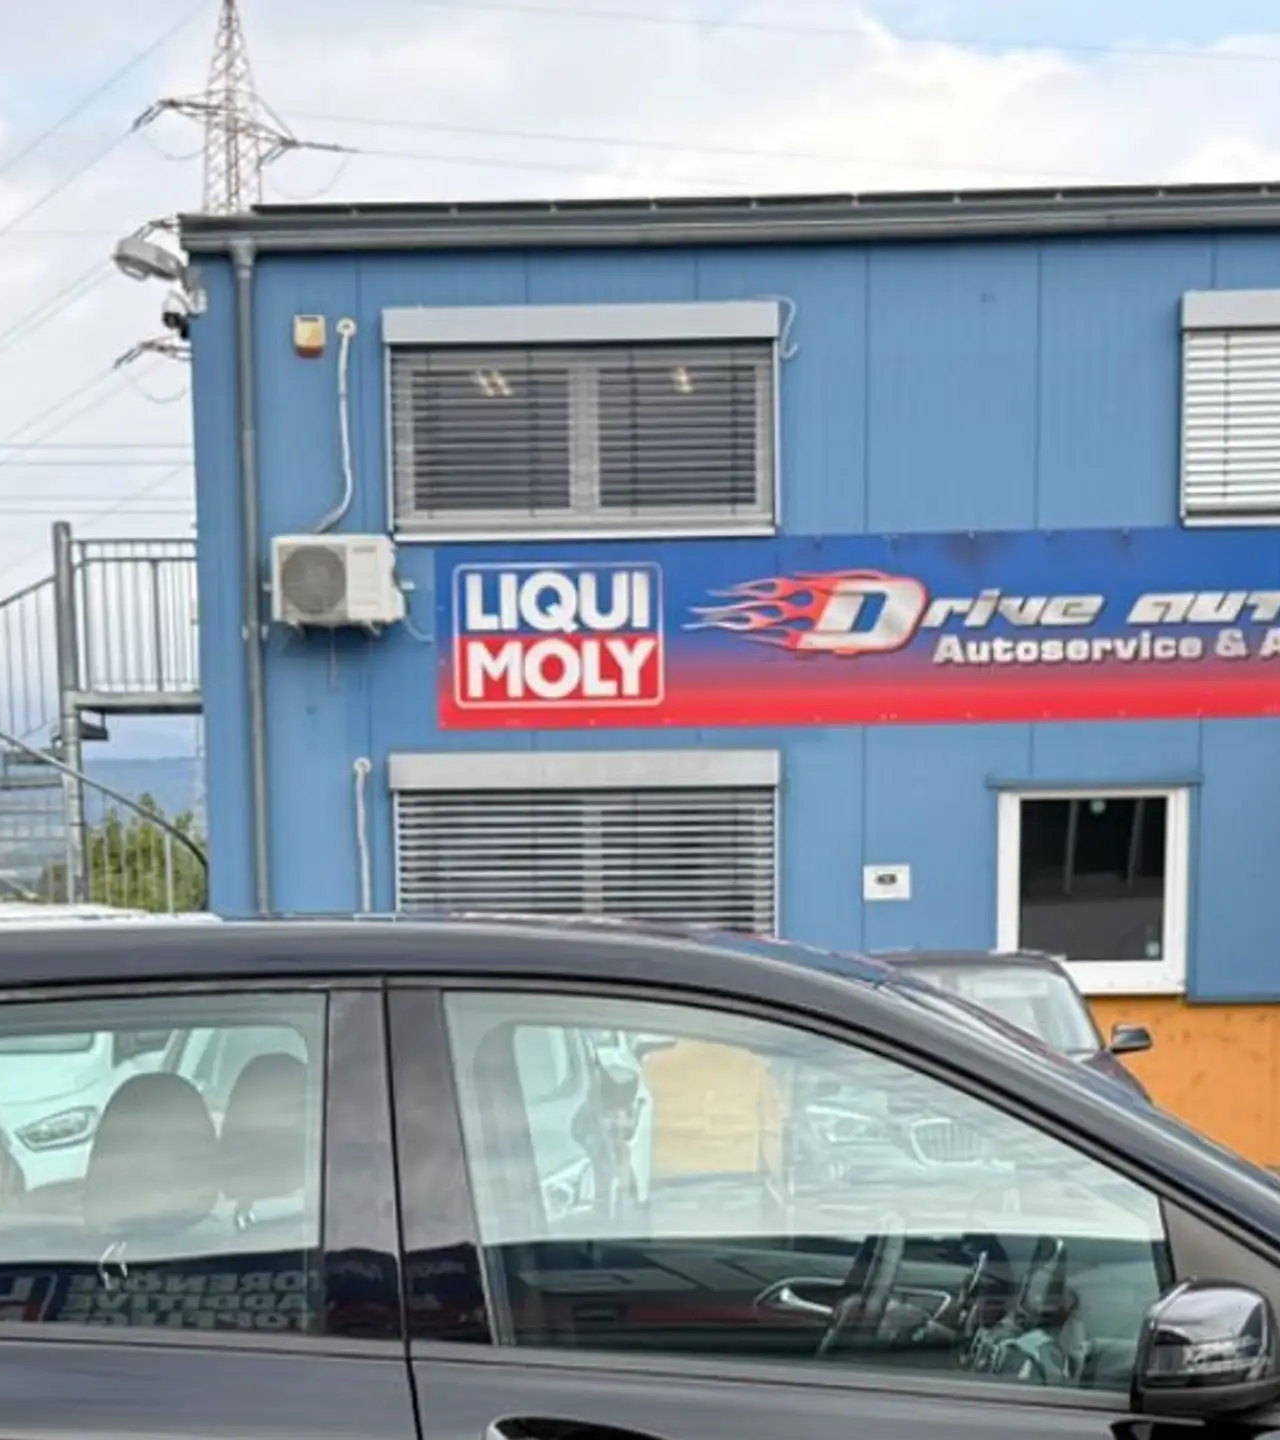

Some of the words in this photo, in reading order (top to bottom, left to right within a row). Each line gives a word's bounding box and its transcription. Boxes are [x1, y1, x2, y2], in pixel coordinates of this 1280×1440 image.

[465, 571, 650, 633] LIQUI
[794, 576, 1106, 652] Drive
[467, 637, 656, 699] MOLY
[932, 629, 1203, 666] Autoservice
[1214, 628, 1247, 658] &
